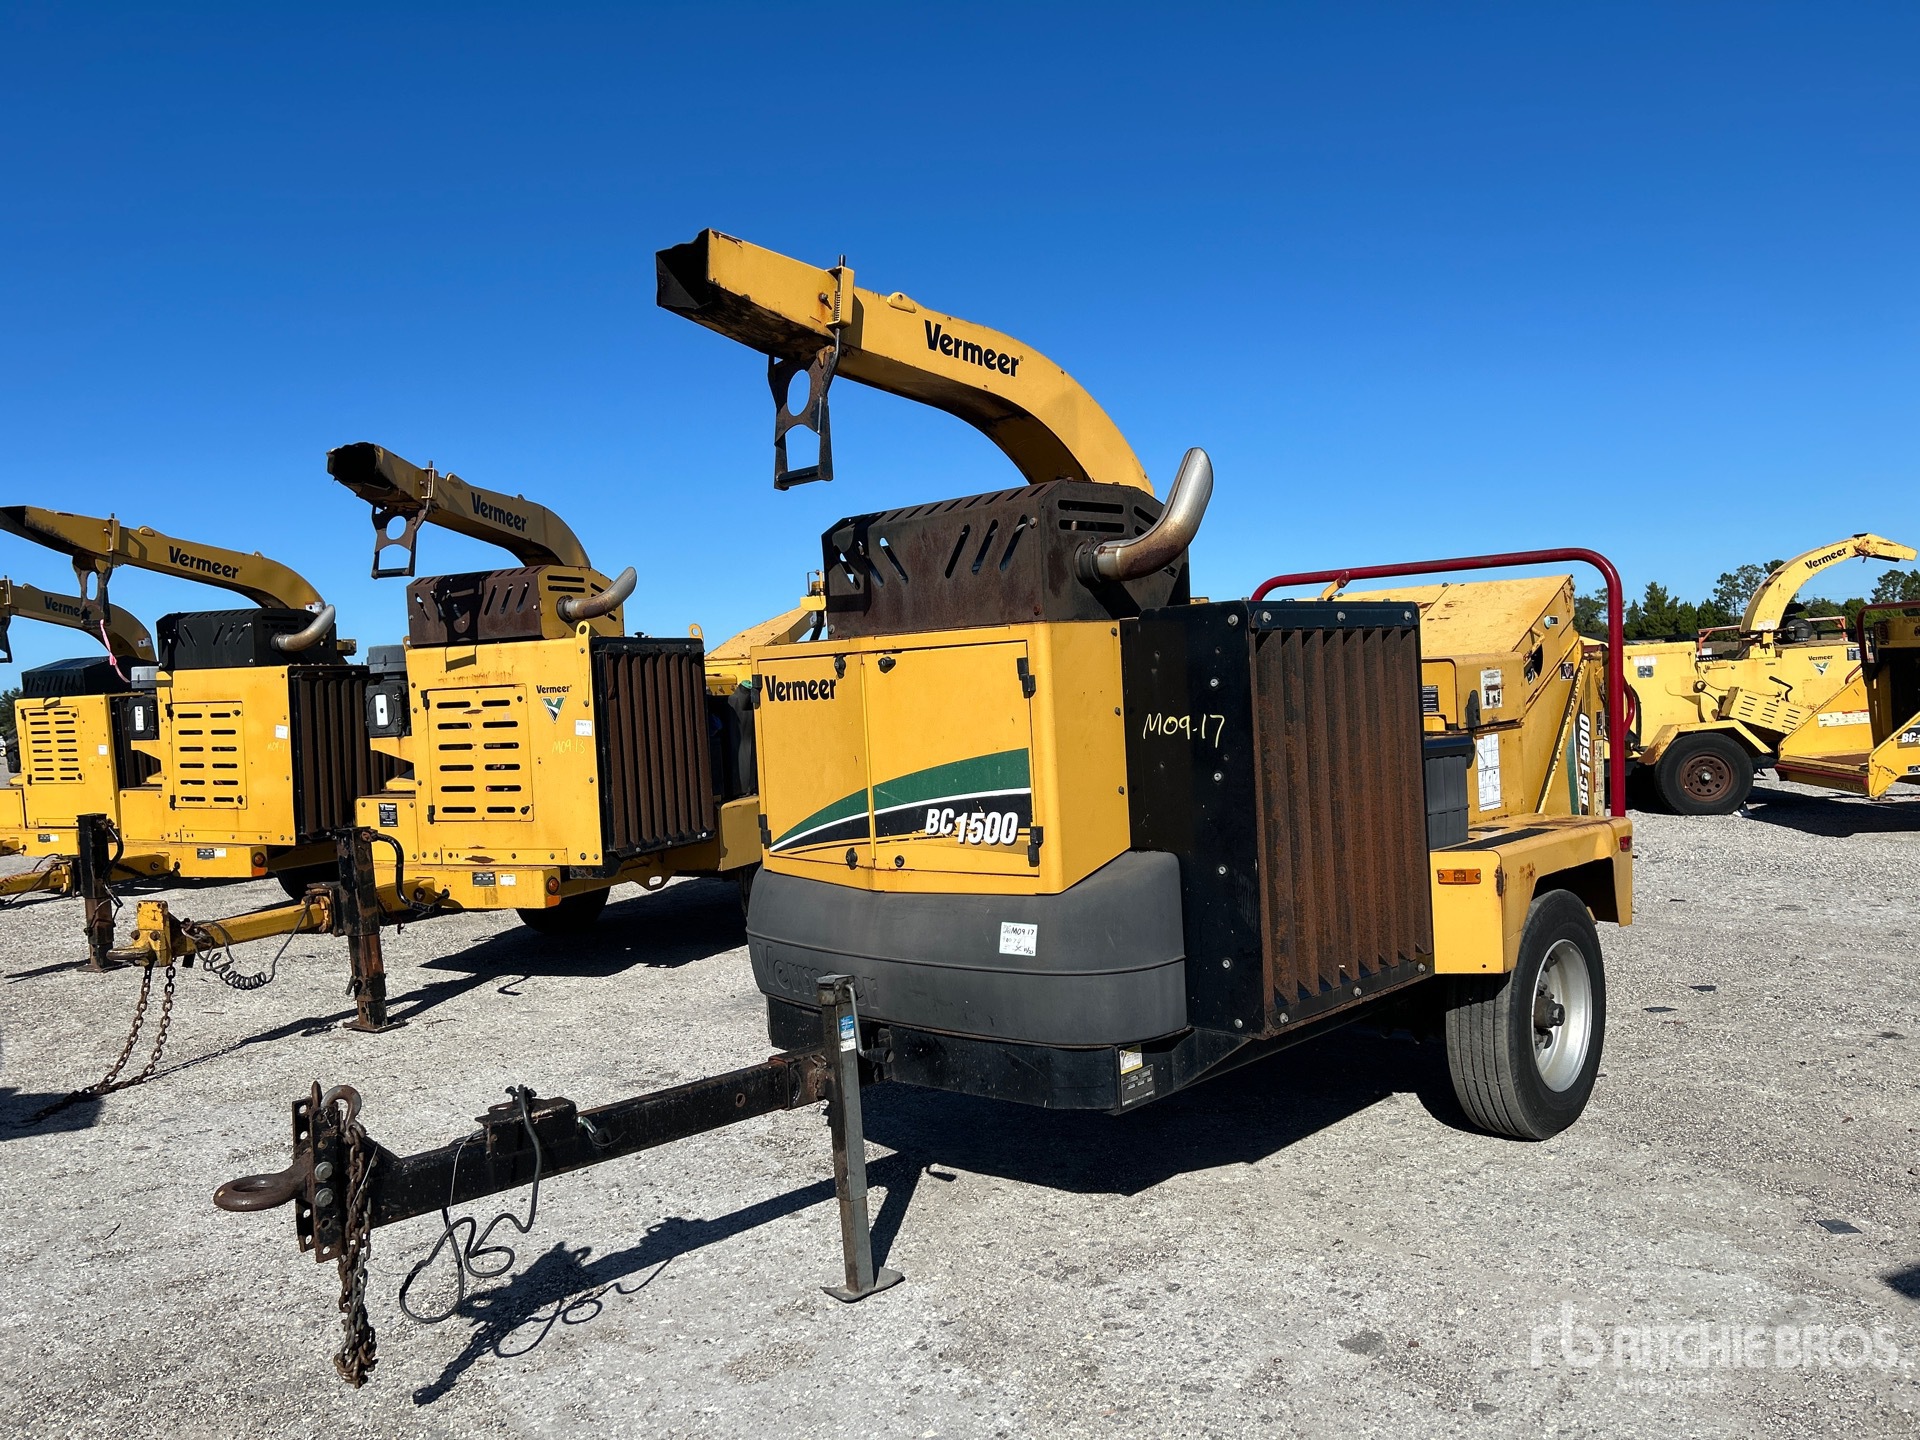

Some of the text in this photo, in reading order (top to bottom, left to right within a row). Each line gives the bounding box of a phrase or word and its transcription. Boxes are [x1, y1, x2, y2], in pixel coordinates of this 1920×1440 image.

[925, 320, 1019, 377] Vermeer
[471, 491, 527, 532] Vermeer
[169, 545, 239, 579] Vermeer
[1805, 547, 1847, 569] Vermeer
[44, 596, 91, 620] Verme
[536, 685, 570, 694] Vermeer
[764, 675, 837, 702] Vermeer
[1579, 713, 1591, 806] BC1500
